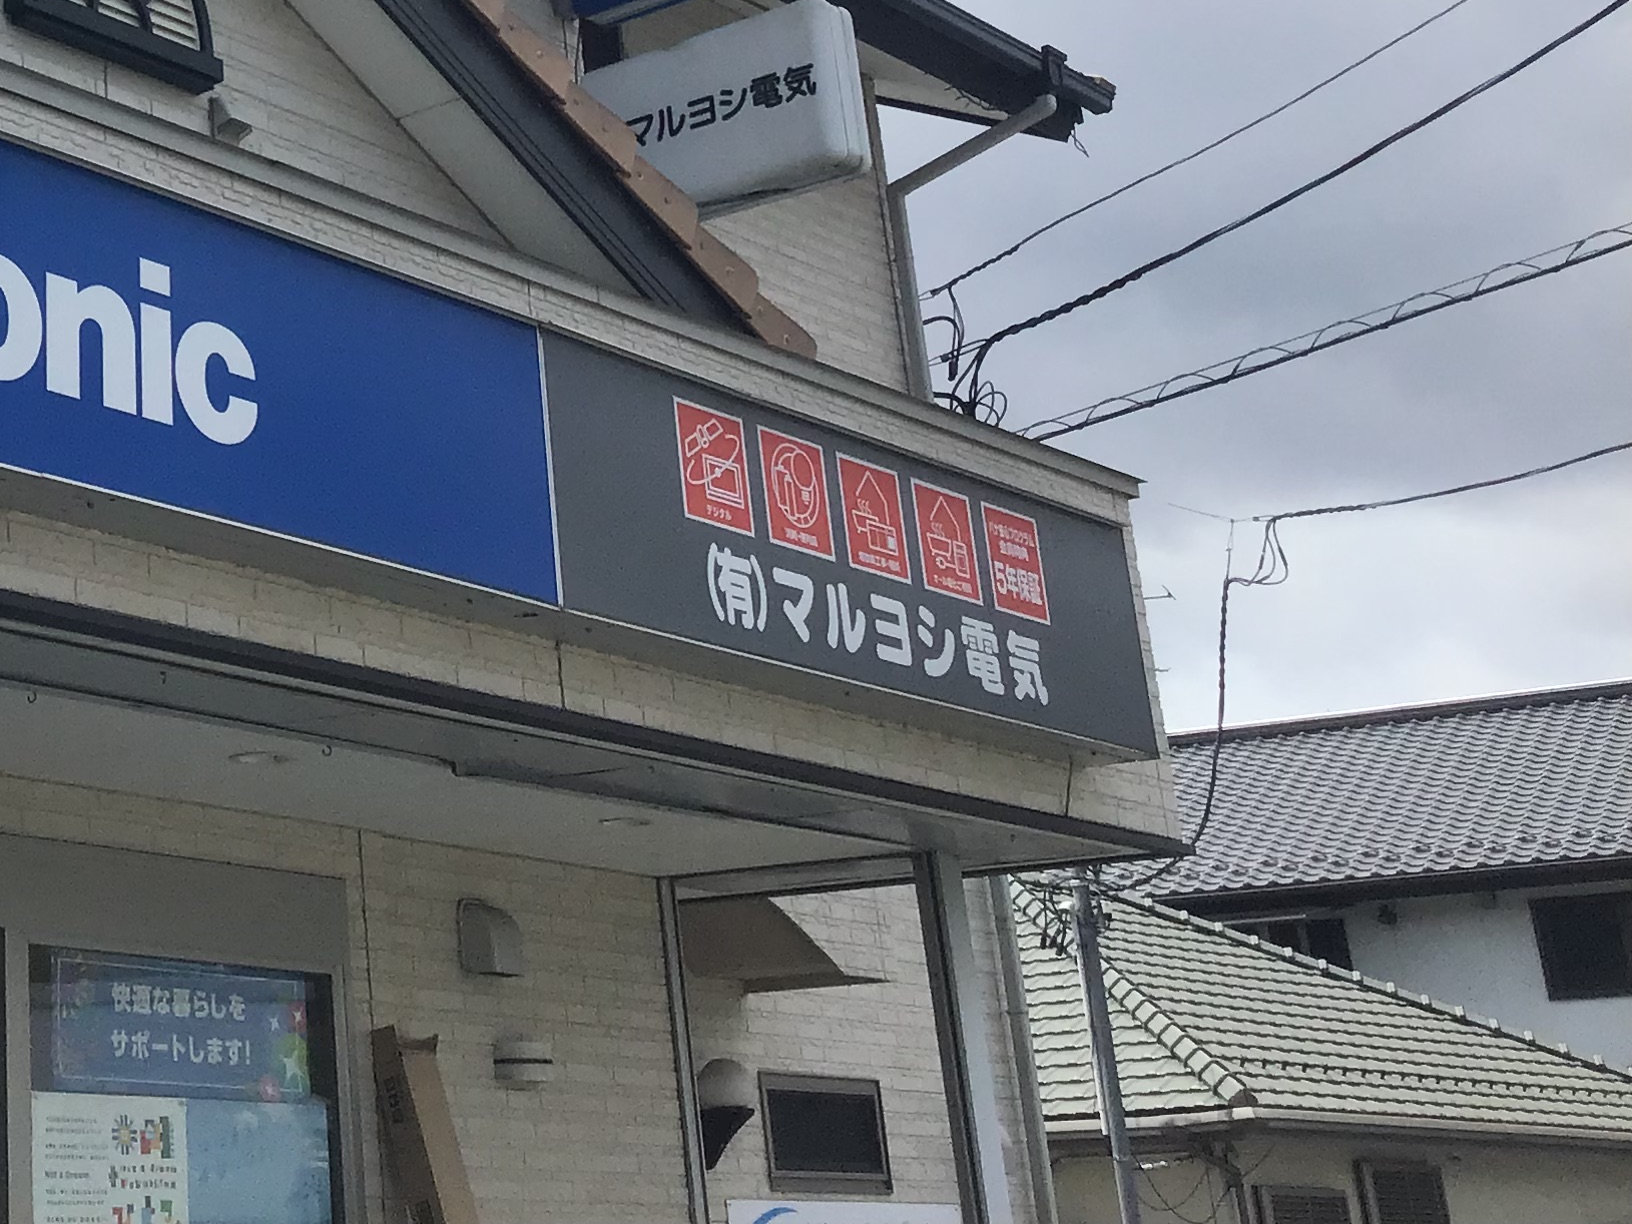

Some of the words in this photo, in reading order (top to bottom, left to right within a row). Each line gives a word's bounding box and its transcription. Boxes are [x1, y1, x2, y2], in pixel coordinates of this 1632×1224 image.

[625, 63, 817, 146] マルヨシ電気
[111, 982, 246, 1021] 快適な暮らしを
